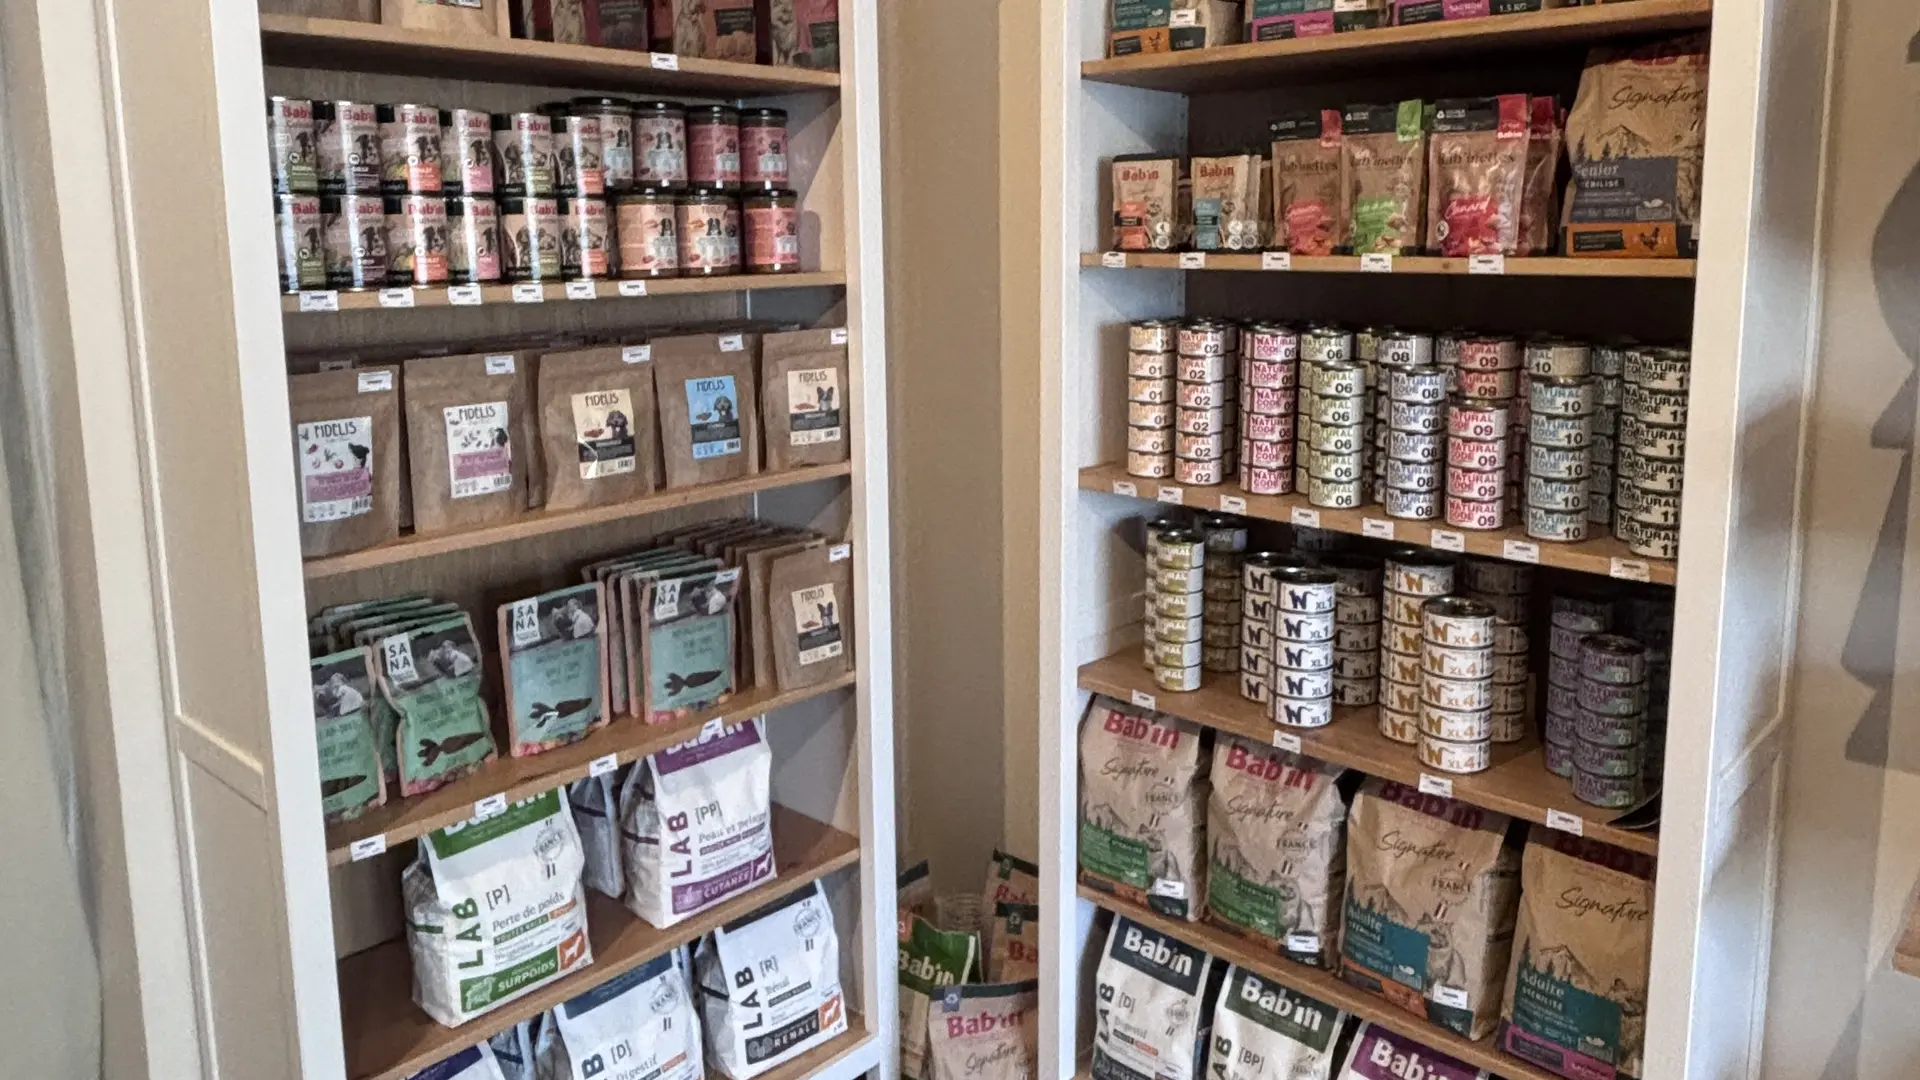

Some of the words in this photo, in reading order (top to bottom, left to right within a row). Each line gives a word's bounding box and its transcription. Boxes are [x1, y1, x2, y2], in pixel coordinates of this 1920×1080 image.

[1204, 344, 1219, 354] 02
[1327, 349, 1343, 359] 06
[1391, 352, 1410, 362] 08
[1480, 357, 1498, 367] 09
[1535, 362, 1551, 373] 10
[799, 370, 828, 382] FIDELIS
[1189, 370, 1205, 379] 02
[696, 380, 726, 393] FIDELIS
[1335, 383, 1353, 393] 06
[1478, 386, 1497, 396] 09
[1422, 389, 1439, 399] 08
[585, 395, 620, 407] FIDELIS
[1194, 396, 1211, 405] 02
[458, 405, 496, 420] FIDELIS
[1562, 401, 1581, 413] 10
[1332, 412, 1349, 422] 06
[314, 421, 357, 438] FIDELIS
[1193, 422, 1209, 431] 02
[1473, 426, 1493, 436] 09
[1565, 433, 1583, 445] 10
[1334, 440, 1352, 450] 06
[1667, 444, 1684, 455] 11
[1195, 448, 1211, 457] 02
[1478, 456, 1497, 466] 09
[1335, 468, 1352, 477] 06
[1566, 464, 1582, 476] 10
[1195, 473, 1211, 482] 02
[1417, 477, 1434, 487] 08
[1478, 486, 1496, 496] 09
[1336, 496, 1352, 505] 06
[1562, 496, 1580, 508] 10
[1416, 506, 1432, 516] 08
[1662, 511, 1678, 522] 11
[1478, 516, 1495, 526] 09
[1563, 527, 1580, 539] 10
[1661, 544, 1678, 556] 11
[1323, 624, 1329, 637] 1
[1471, 631, 1480, 643] 4
[1323, 652, 1329, 665] 1
[1465, 662, 1477, 676] 4
[1323, 681, 1329, 694] 1
[1464, 693, 1475, 706] 4
[1323, 710, 1329, 721] 1
[1463, 722, 1475, 737] 4
[1464, 755, 1475, 769] 4
[668, 810, 693, 879] LAB
[1556, 887, 1649, 923] Signature
[492, 913, 521, 932] Perte
[522, 904, 536, 918] de
[538, 892, 565, 912] poids
[451, 897, 484, 970] LAB
[498, 959, 556, 992] SURPOIDS
[1521, 969, 1565, 998] Adulte
[735, 964, 763, 1032] LAB
